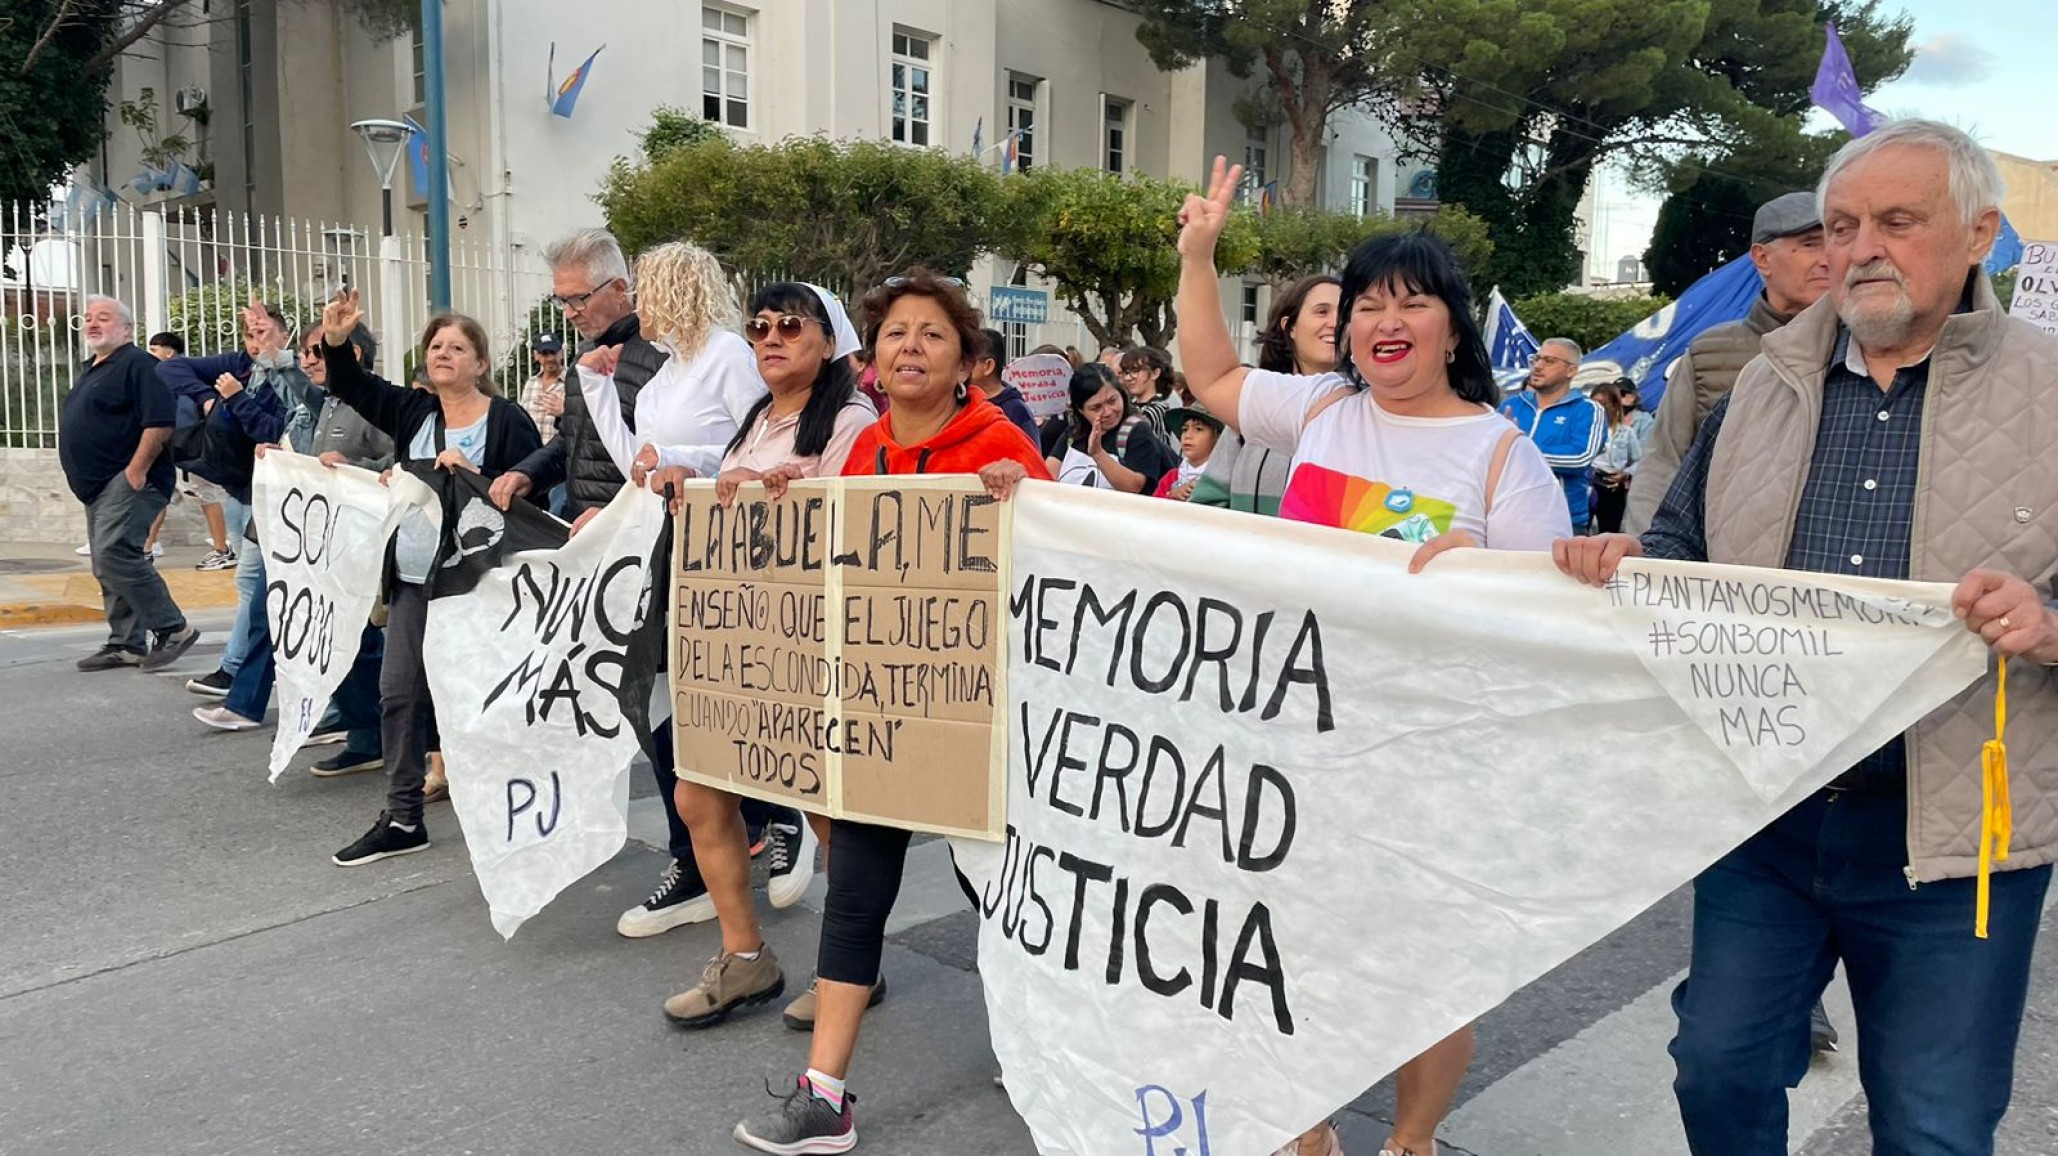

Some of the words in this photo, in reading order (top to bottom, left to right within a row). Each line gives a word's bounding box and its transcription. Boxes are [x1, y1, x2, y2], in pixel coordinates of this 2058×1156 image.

[2013, 296, 2043, 309] LOS
[683, 502, 723, 571] LA
[917, 493, 1001, 575] ME
[781, 591, 825, 646] QUE
[844, 595, 884, 646] EL
[889, 595, 988, 652] JUEGO
[1008, 573, 1335, 733] MEMORIA
[481, 642, 629, 739] MÁS
[679, 635, 704, 681] DE
[707, 641, 736, 686] LA
[1689, 662, 1808, 699] NUNCA
[675, 690, 749, 737] CUANDO
[1719, 704, 1807, 747] MAS
[732, 739, 821, 795] TODOS
[1020, 701, 1297, 872] VERDAD
[506, 770, 562, 842] PJ
[981, 823, 1294, 1036] JUSTICIA
[1133, 1083, 1210, 1156] PJ
